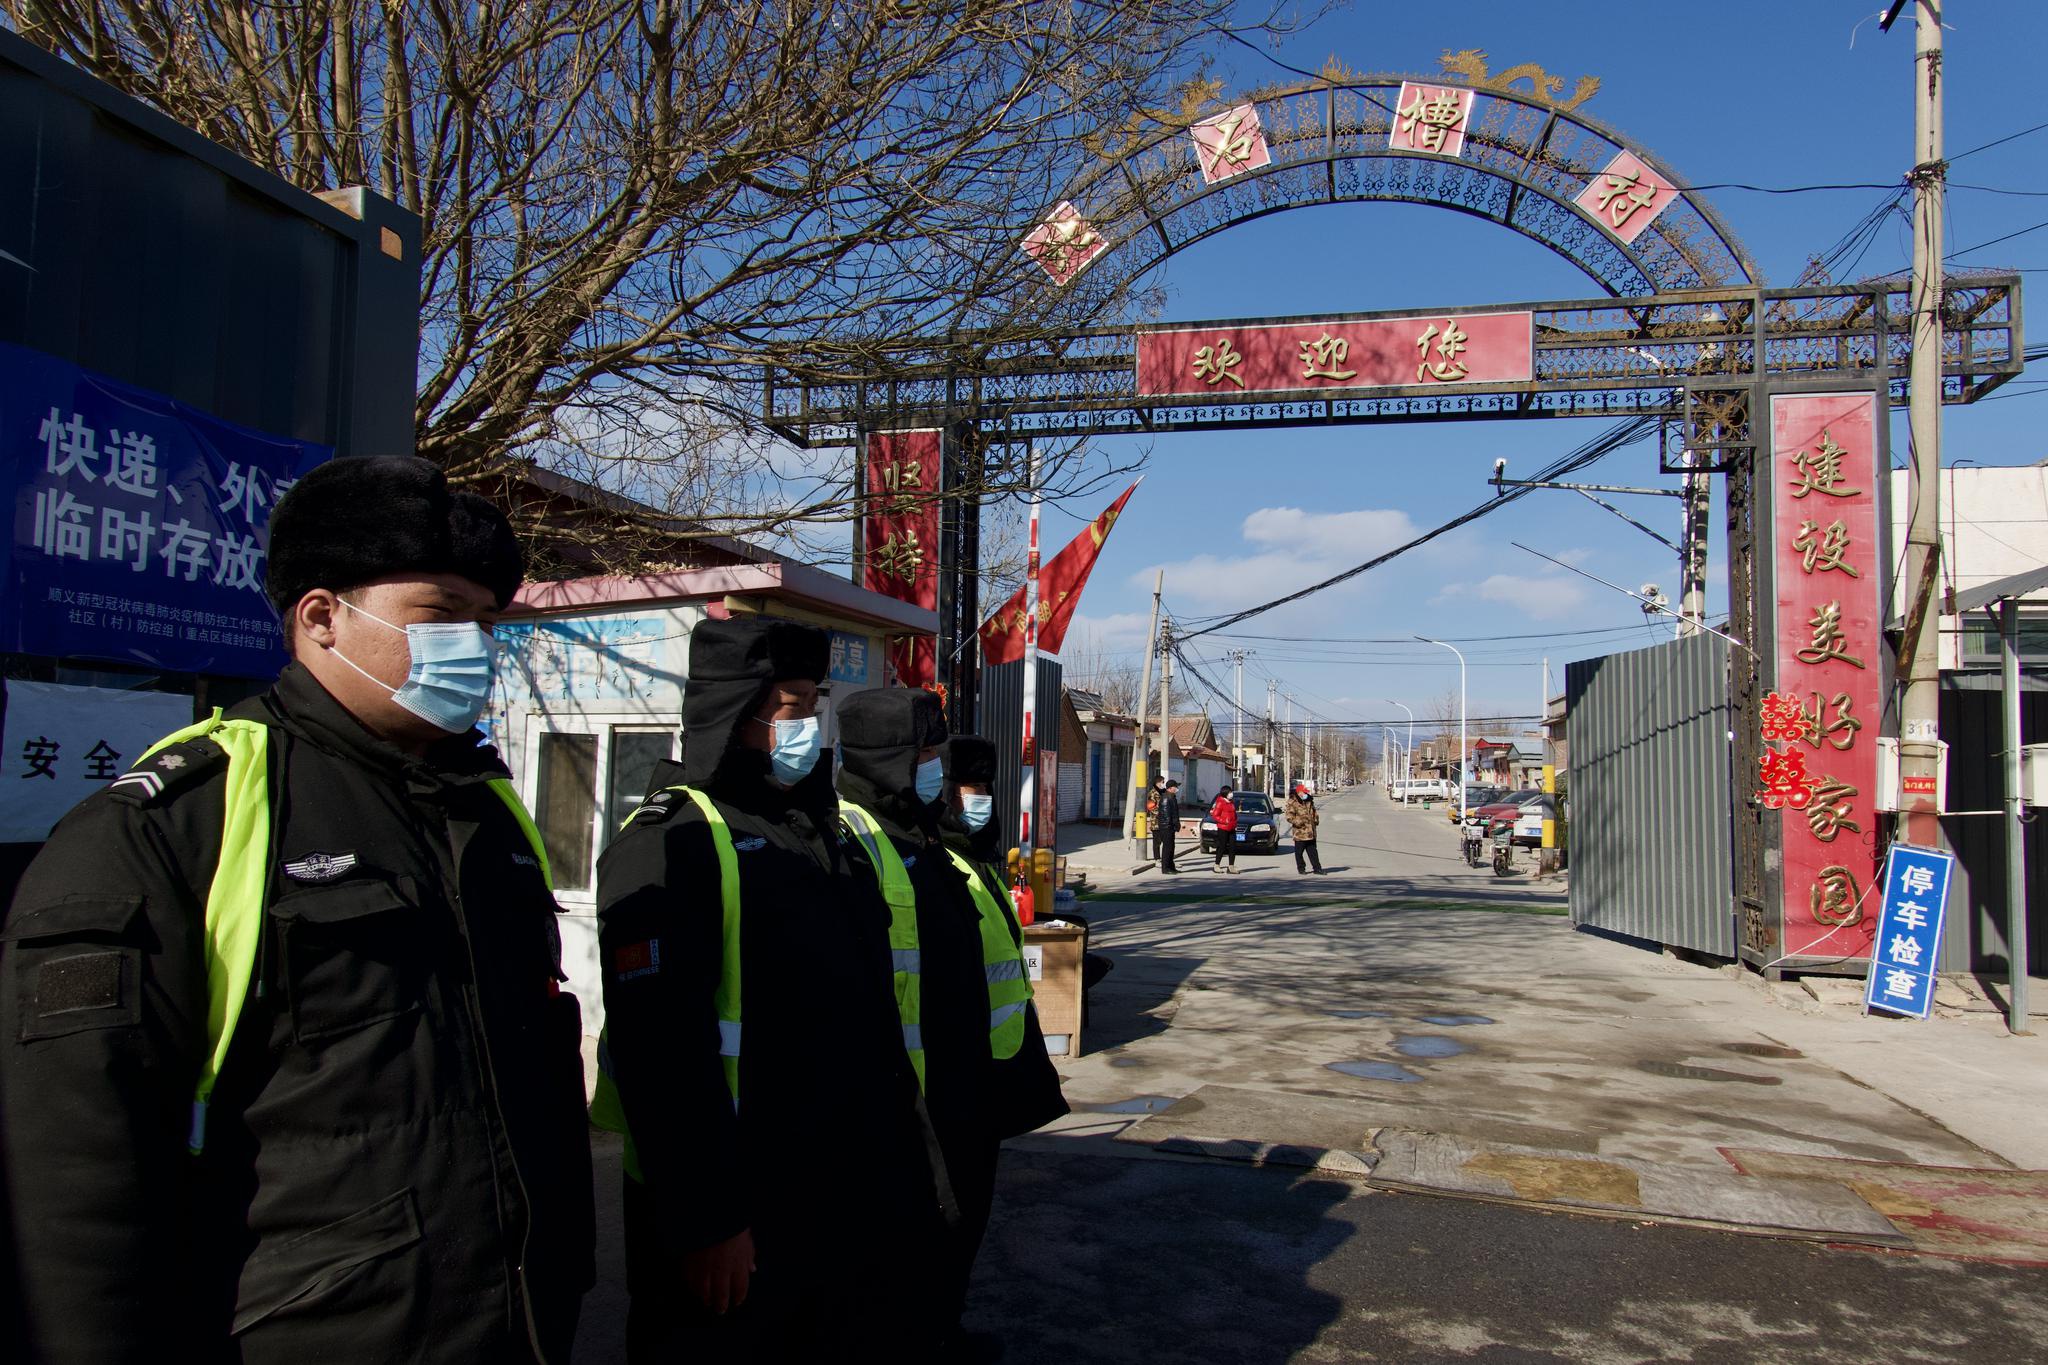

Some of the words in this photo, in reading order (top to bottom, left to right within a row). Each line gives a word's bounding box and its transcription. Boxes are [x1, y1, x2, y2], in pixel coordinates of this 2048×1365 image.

[1193, 318, 1469, 388] 欢迎您
[38, 406, 298, 524] 快递、外
[32, 488, 267, 594] 临时存放
[47, 586, 283, 637] 顺义新型冠状病毒肺炎疫情防控工作领导小
[1790, 430, 1864, 928] 建设美好家园
[21, 735, 124, 781] 安全
[1884, 863, 1937, 1000] 停车检查
